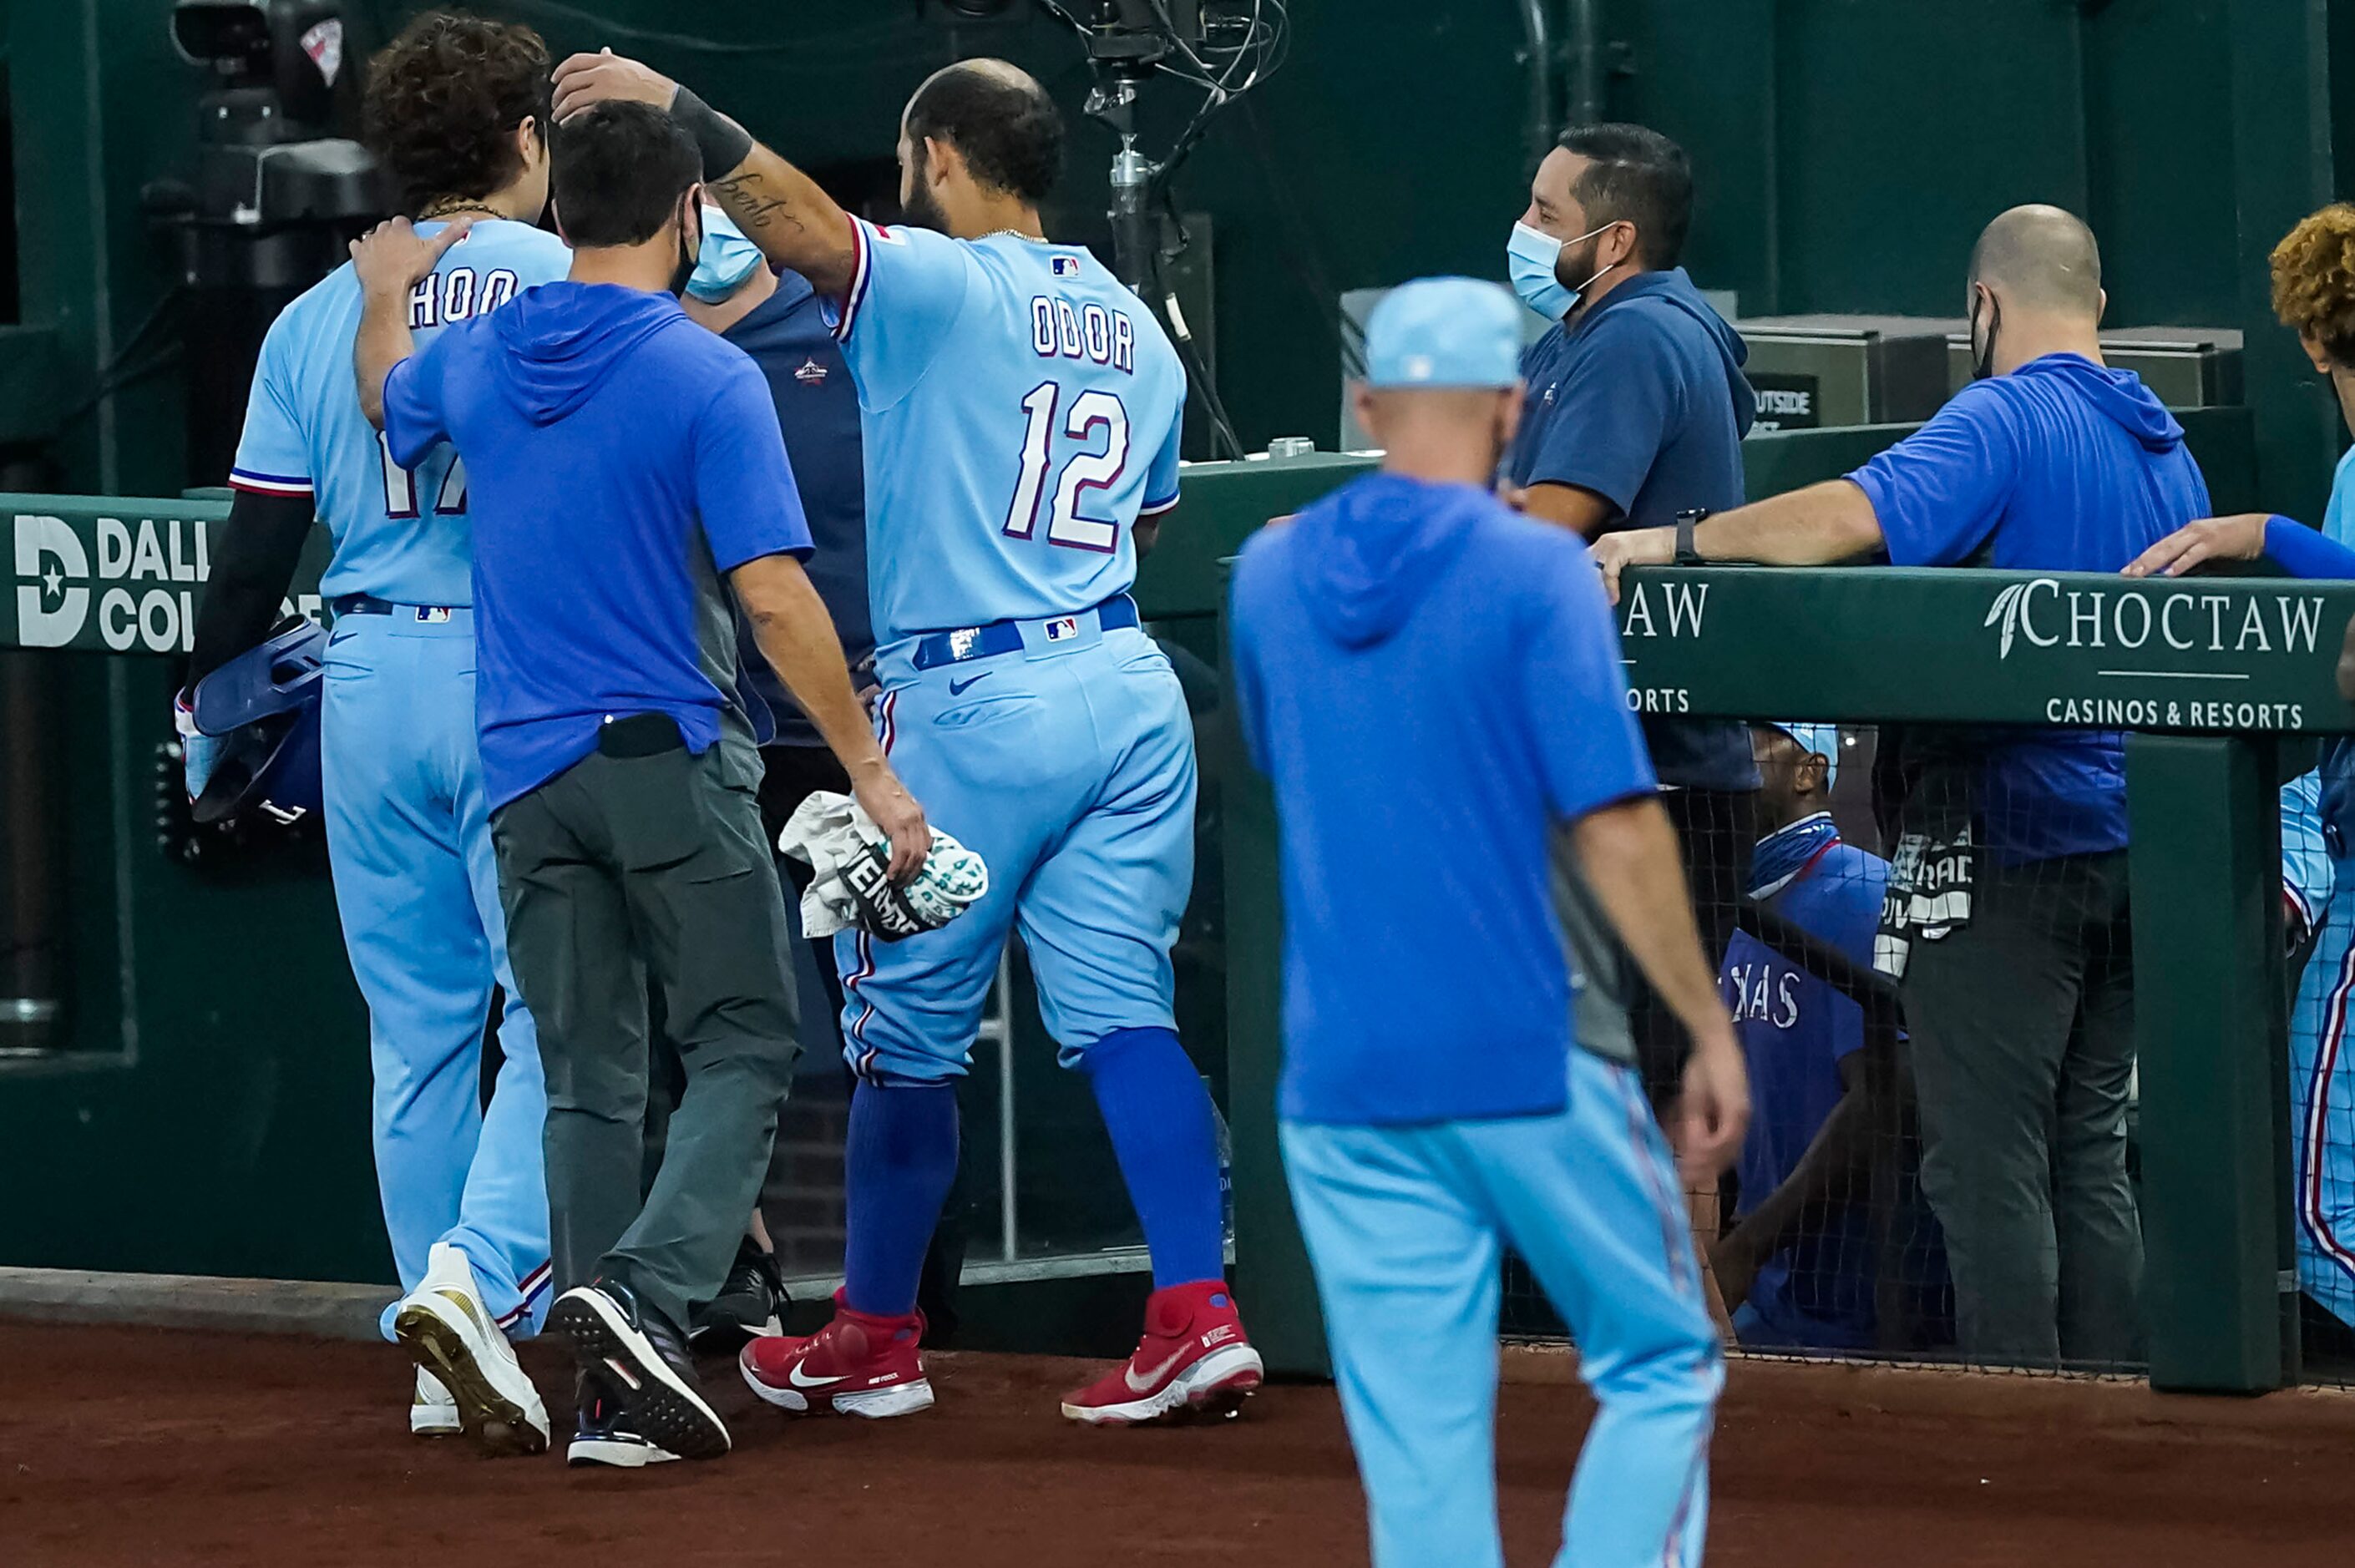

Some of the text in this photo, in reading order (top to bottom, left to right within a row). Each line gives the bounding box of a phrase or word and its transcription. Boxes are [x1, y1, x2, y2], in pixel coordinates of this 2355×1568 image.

[408, 266, 519, 330] HOO
[1031, 296, 1134, 376] ODOR
[1755, 390, 1811, 415] UTSIDE
[1002, 380, 1129, 554] 12
[97, 518, 211, 582] DALL
[2020, 579, 2325, 654] CHOCTAW
[1626, 688, 1689, 713] ORTS
[2046, 698, 2303, 730] CASINOS & RESORTS
[1730, 964, 1800, 1029] XAS
